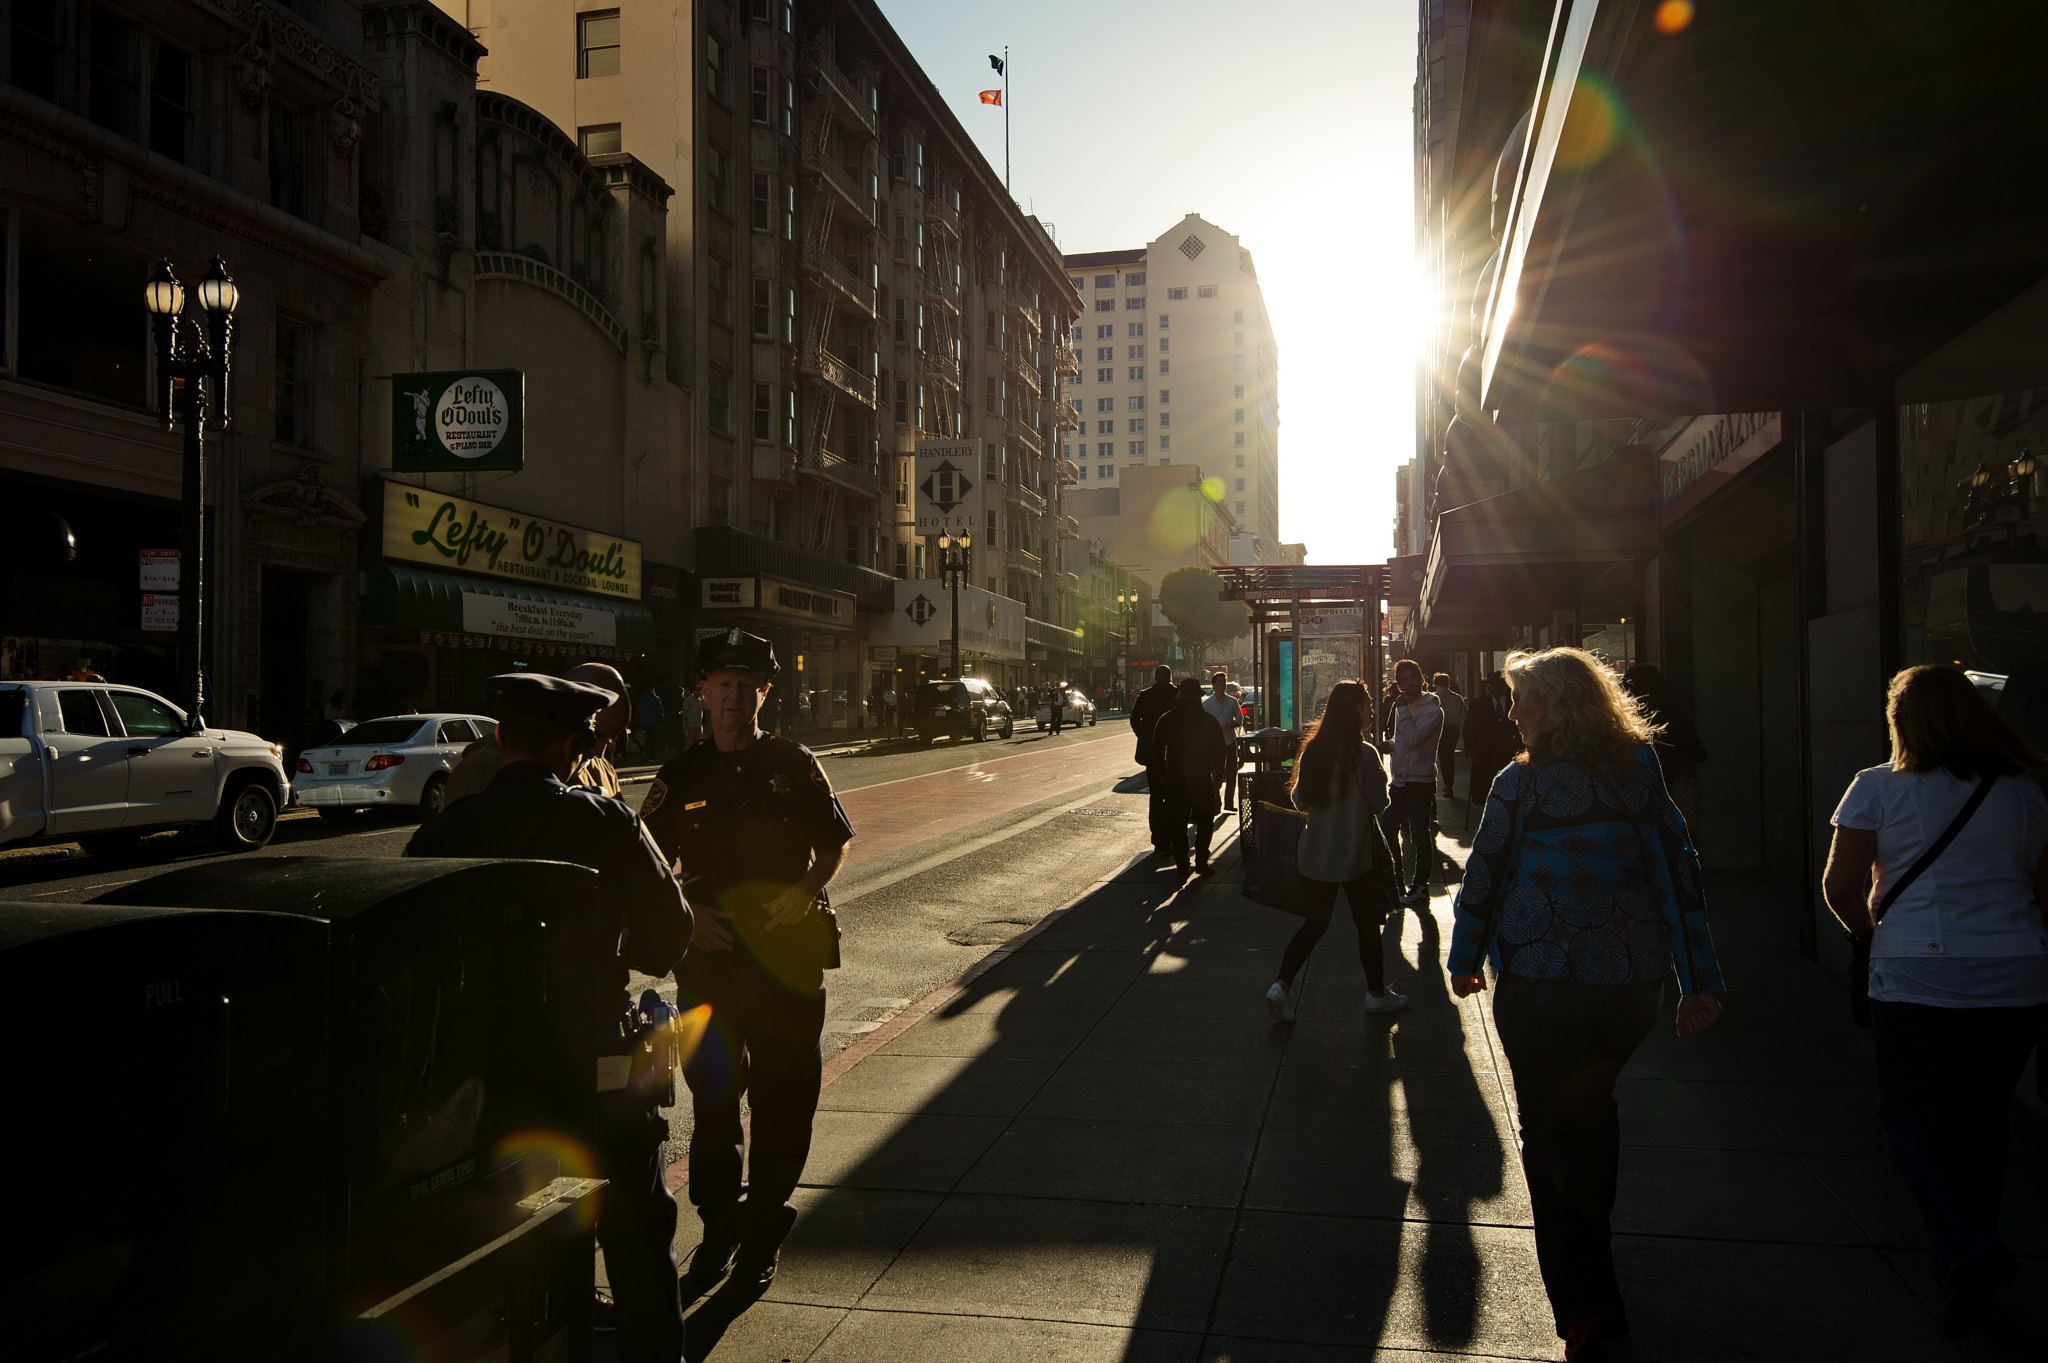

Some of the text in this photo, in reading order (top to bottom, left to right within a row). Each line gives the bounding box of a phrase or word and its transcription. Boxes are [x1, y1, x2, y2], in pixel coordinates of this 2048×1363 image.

[441, 405, 502, 427] O'Doul's
[445, 430, 497, 440] RESTAURANT
[456, 442, 477, 450] PIANO
[478, 441, 492, 449] BAR
[920, 446, 974, 458] HANDLERY
[919, 516, 976, 527] HOTEL
[142, 557, 153, 565] NO
[498, 560, 629, 594] RESTAURANT & COCKTAIL LOUNGE
[709, 582, 742, 592] DAILY
[1327, 588, 1352, 597] RAPID
[779, 587, 811, 611] DAILY
[1262, 590, 1287, 599] RAPID
[143, 597, 178, 606] NO PARKING
[507, 601, 583, 621] Breakfast Everyday
[514, 613, 541, 624] 7:00a.m.
[542, 617, 548, 625] to
[511, 622, 526, 634] best
[527, 625, 544, 635] deal
[556, 628, 567, 638] the
[144, 978, 184, 1009] PULL
